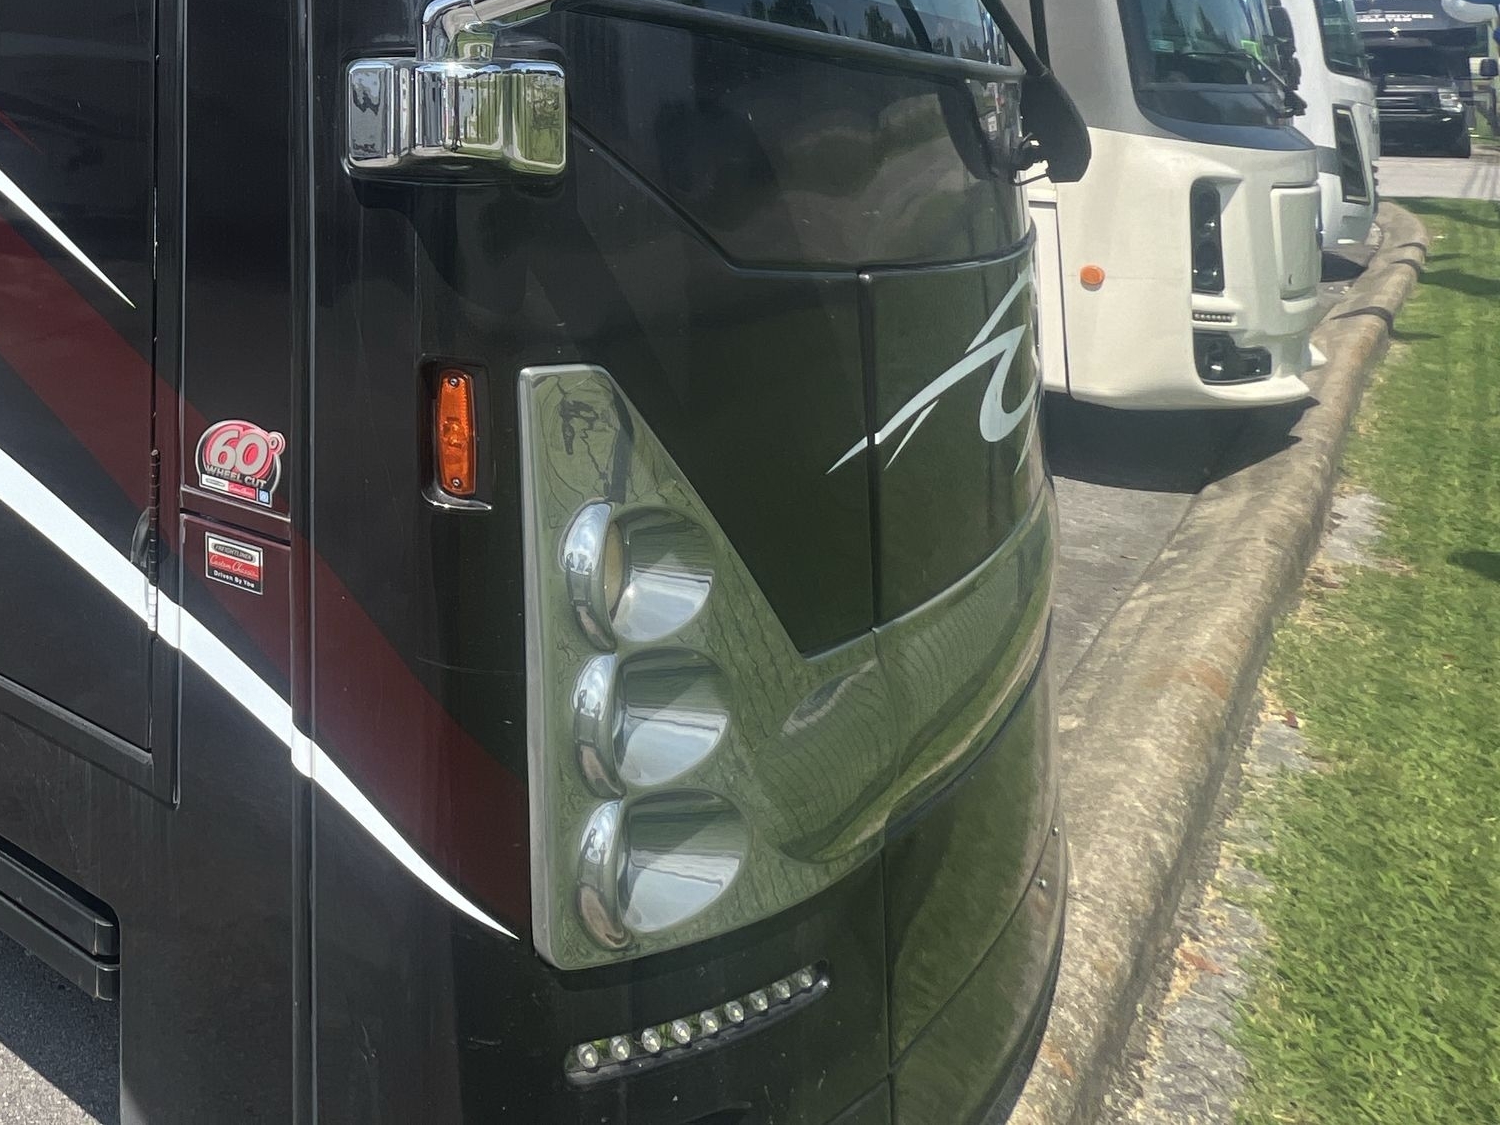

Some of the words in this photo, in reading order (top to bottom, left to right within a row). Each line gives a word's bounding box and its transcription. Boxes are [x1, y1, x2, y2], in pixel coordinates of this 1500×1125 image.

[206, 464, 242, 481] WHEEL
[244, 475, 267, 488] CUT
[213, 569, 234, 582] Driven
